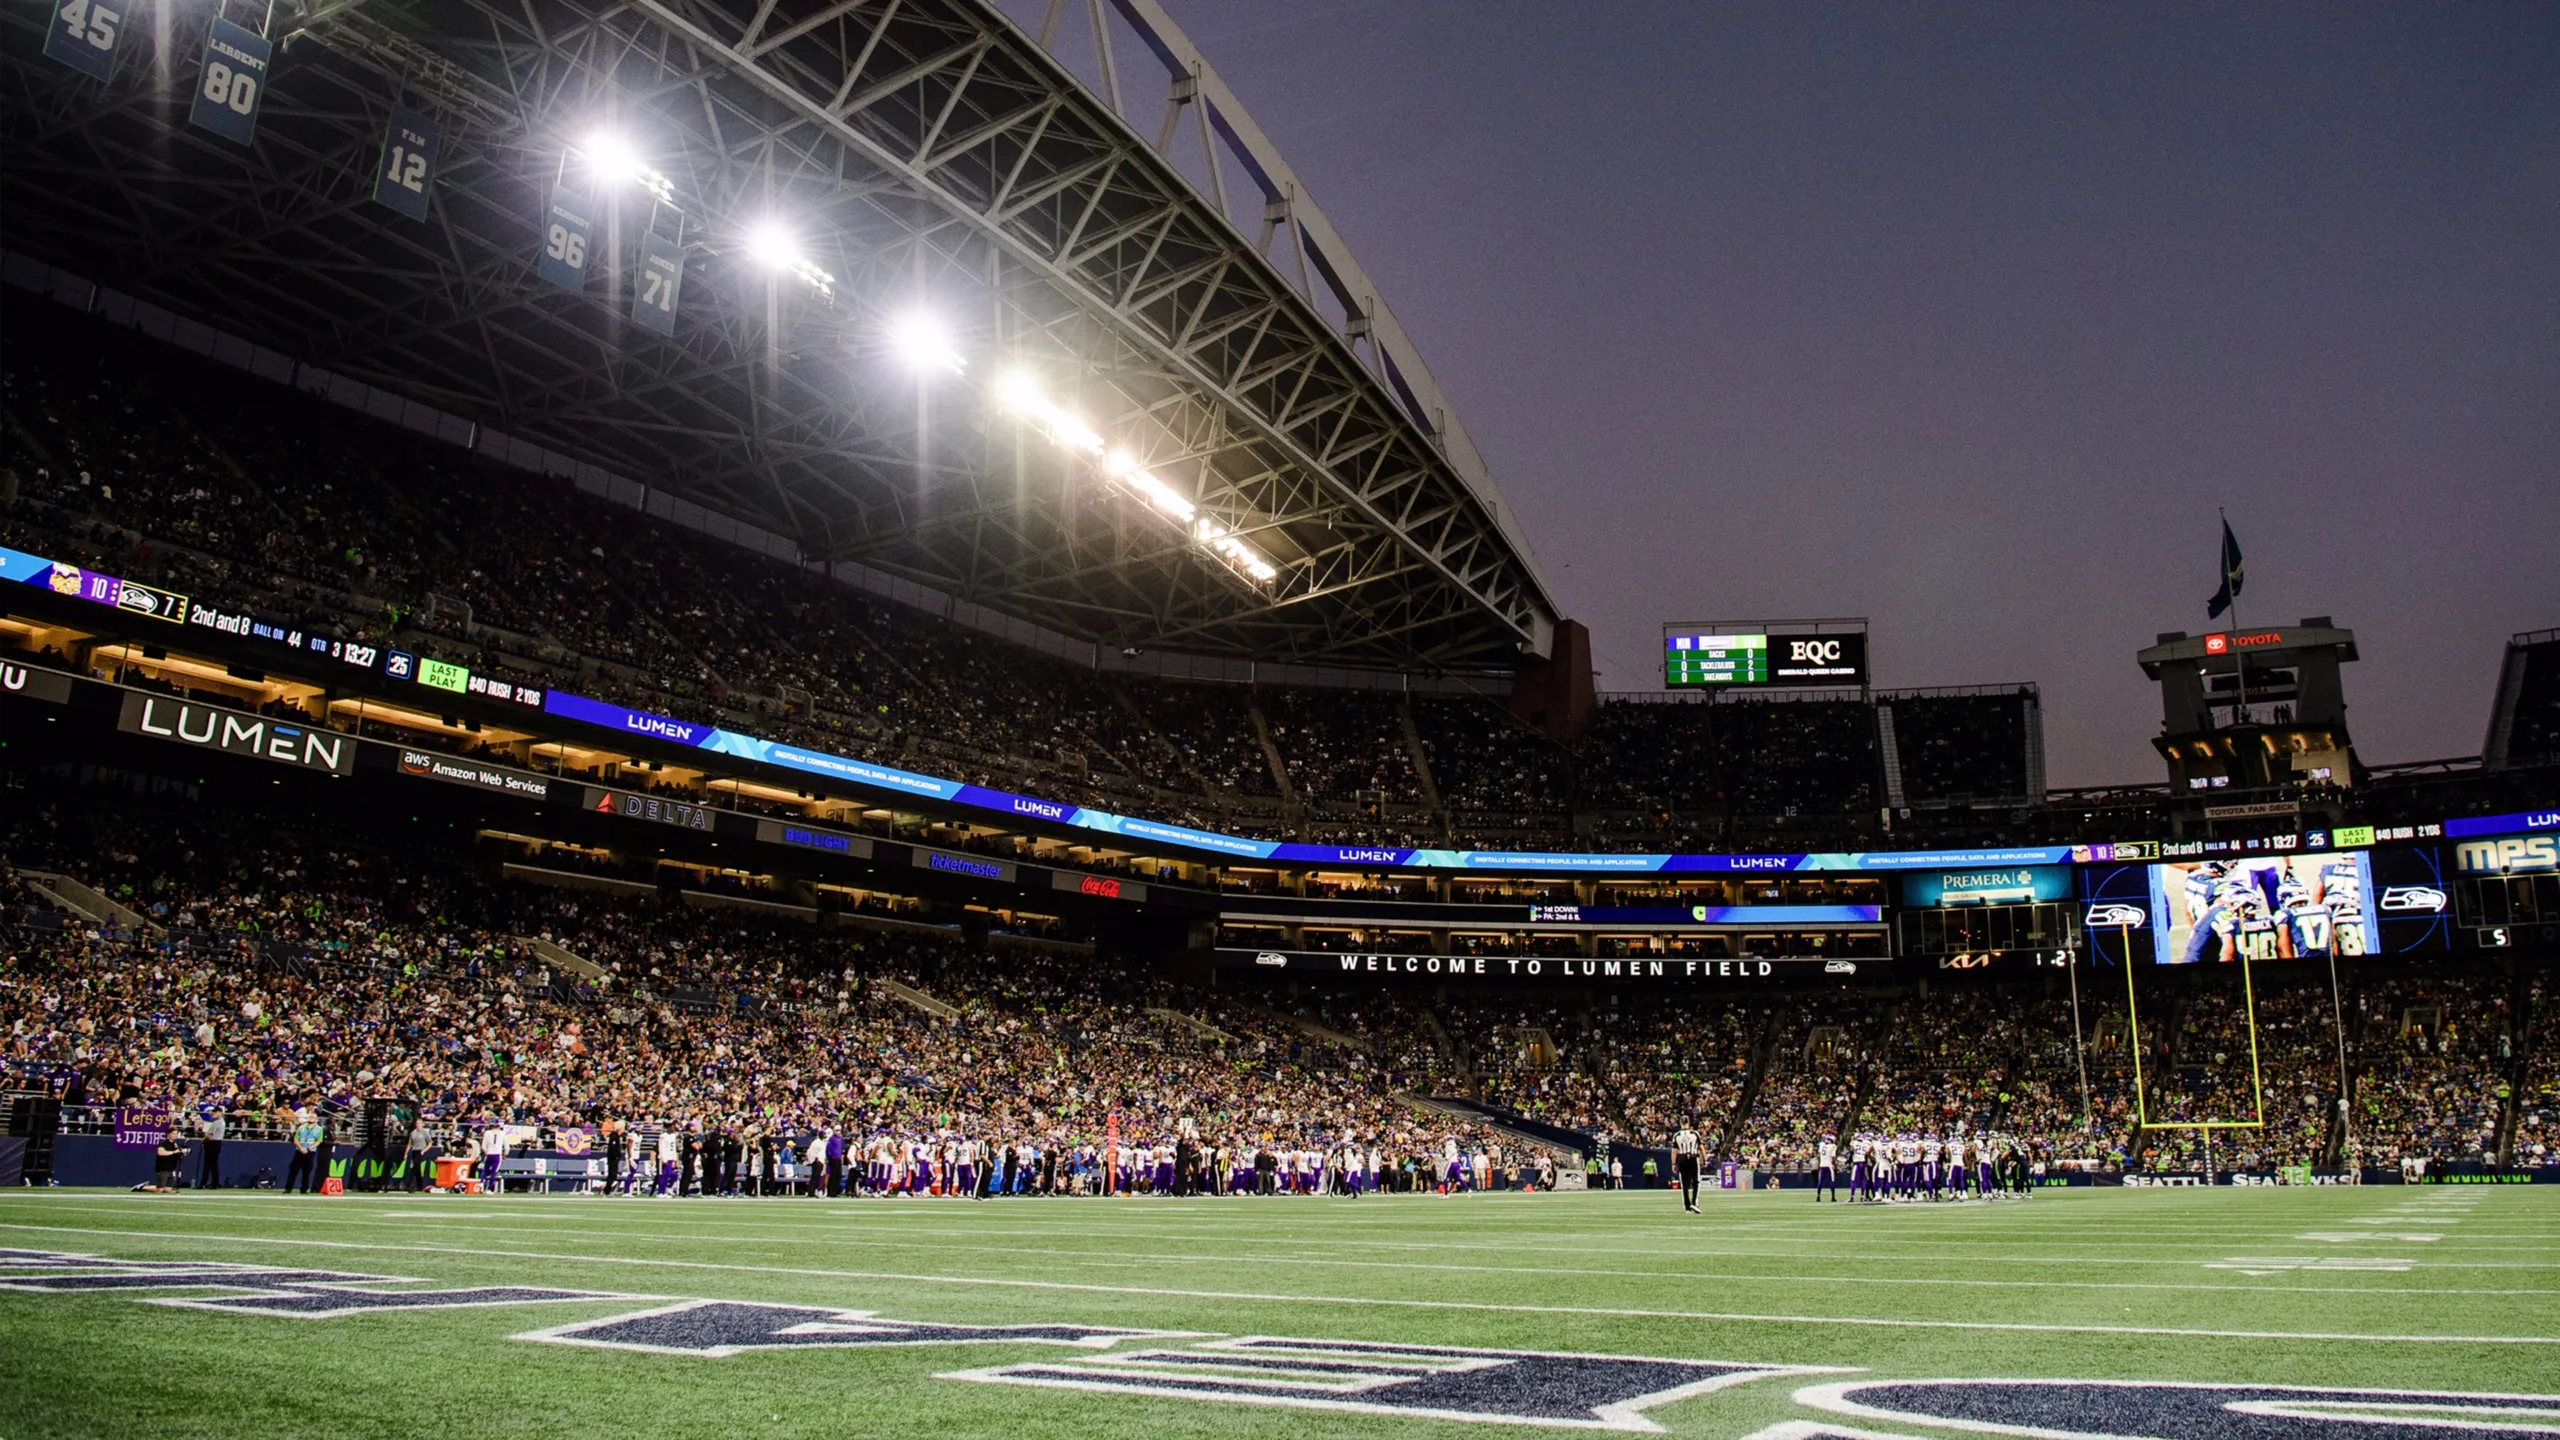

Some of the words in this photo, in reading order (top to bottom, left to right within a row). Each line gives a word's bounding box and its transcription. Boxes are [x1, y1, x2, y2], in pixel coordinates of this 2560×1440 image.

[60, 0, 120, 51] 45
[210, 38, 266, 71] LARGENT
[203, 61, 256, 116] 80
[402, 128, 425, 147] FAN
[387, 145, 427, 194] 12
[546, 223, 586, 269] 96
[642, 269, 673, 312] 71
[91, 577, 108, 599] 10
[163, 596, 175, 616] 7
[190, 604, 217, 627] 2nd
[216, 611, 241, 634] and
[240, 616, 251, 636] 8
[253, 623, 272, 638] BALL
[273, 628, 285, 641] ON
[287, 631, 302, 648] 44
[311, 638, 327, 652] QTR
[332, 641, 341, 657] 3
[344, 643, 377, 667] 13:27
[2231, 633, 2281, 647] TOYOTA
[1790, 640, 1841, 665] EQC
[431, 662, 458, 678] LAST
[1830, 667, 1856, 675] CASINO
[429, 674, 457, 689] PLAY
[487, 680, 511, 700] RUSH
[516, 687, 524, 702] 2
[523, 689, 541, 706] YDS
[141, 699, 341, 769] LUMEN
[627, 714, 693, 740] LUMEN
[404, 751, 431, 769] aws
[432, 762, 477, 781] Amazon
[479, 770, 502, 788] Web
[505, 776, 547, 796] Services
[774, 750, 806, 763] DIGITALLY
[806, 757, 846, 772] CONNECTING
[872, 771, 887, 780] DATA
[888, 775, 900, 783] AND
[901, 777, 941, 792] APPLICATIONS
[624, 796, 706, 828] DELTA
[1014, 799, 1063, 818] LUMEN
[2210, 806, 2246, 817] TOYOTA
[2248, 805, 2266, 814] FAN
[2269, 803, 2295, 812] DECK
[784, 828, 811, 845] BUD
[813, 833, 851, 852] LIGHT
[2343, 829, 2364, 837] LAST
[2344, 837, 2366, 845] PLAY
[2392, 827, 2413, 839] RUSH
[2418, 826, 2425, 837] 2
[2425, 824, 2441, 836] YDS
[2096, 846, 2107, 859] 10
[2143, 844, 2150, 857] 7
[2163, 842, 2179, 855] 2nd
[2179, 842, 2196, 854] and
[2196, 840, 2203, 853] 8
[2205, 842, 2218, 850] BALL
[2218, 842, 2226, 850] ON
[2230, 839, 2241, 850] 44
[2246, 840, 2259, 849] QTR
[2264, 837, 2270, 848] 3
[2273, 834, 2297, 849] 13:27
[930, 853, 1002, 878] ticketmaster
[1339, 850, 1396, 862] LUMEN
[1475, 856, 1505, 864] DIGITALLY
[1506, 857, 1545, 865] CONNECTING
[1590, 858, 1602, 866] AND
[1730, 858, 1787, 868] LUMEN
[1900, 855, 1940, 863] CONNECTING
[1969, 853, 1984, 861] DATA
[2001, 852, 2046, 860] APPLICATIONS
[1943, 873, 2011, 889] PREMERA
[2296, 914, 2331, 950] 17
[1340, 955, 1486, 974] WELCOME
[1508, 960, 1541, 974] TO
[1564, 961, 1663, 976] LUMEN
[1686, 961, 1772, 976] FIELD
[124, 1109, 153, 1126] Let's
[154, 1112, 171, 1127] go!
[1902, 1147, 1916, 1157] 59
[457, 1164, 469, 1180] G
[2122, 1174, 2206, 1187] SEATTL
[329, 1179, 341, 1192] 20
